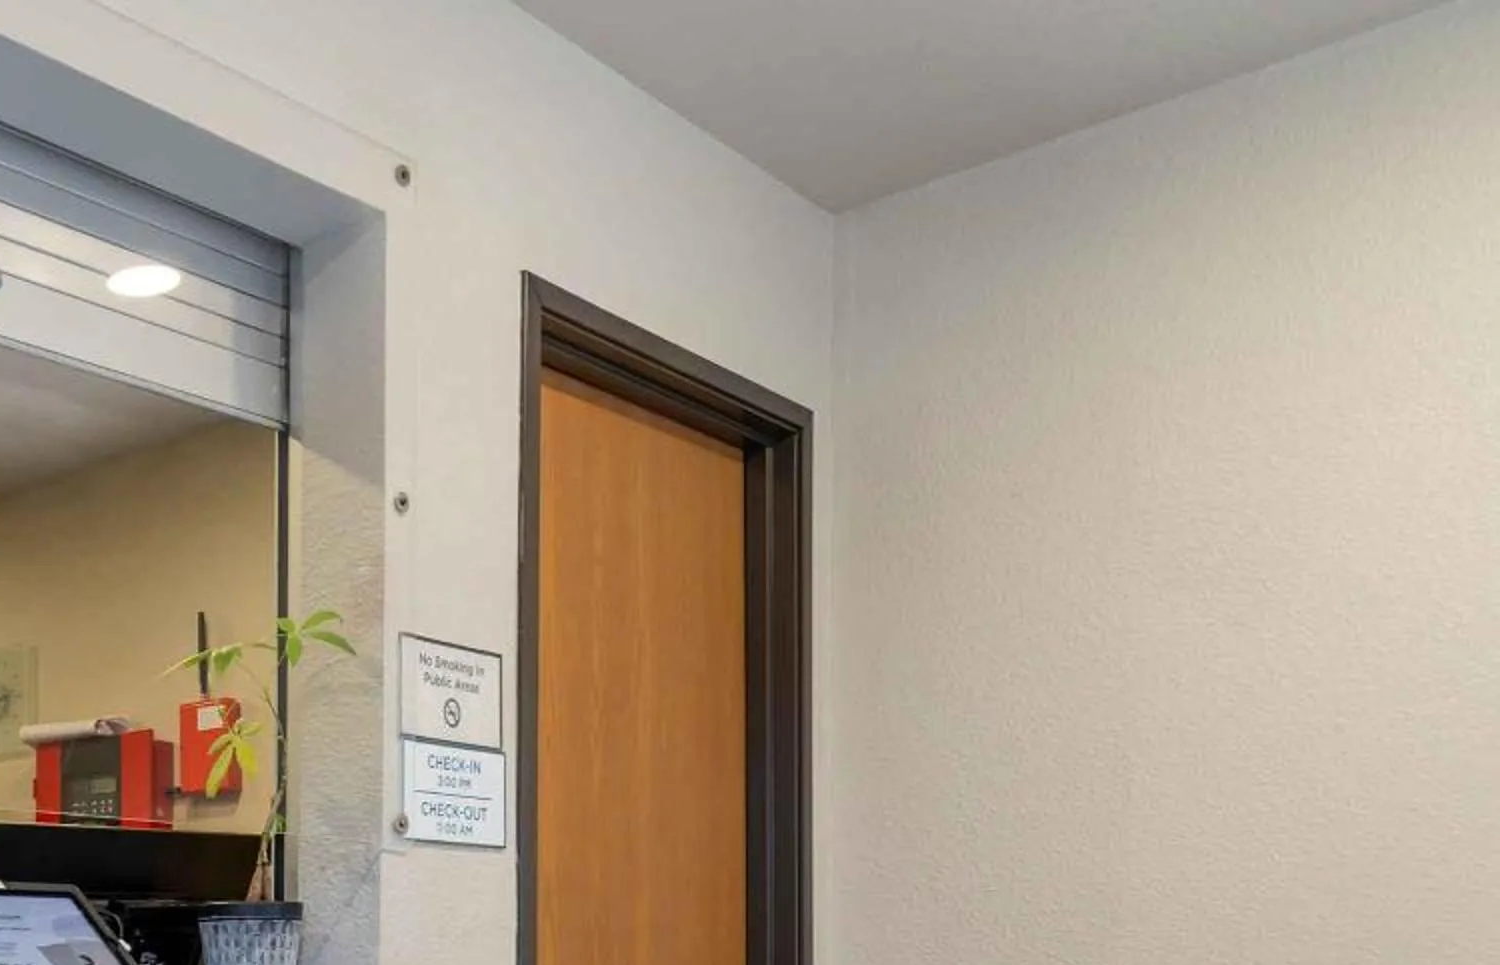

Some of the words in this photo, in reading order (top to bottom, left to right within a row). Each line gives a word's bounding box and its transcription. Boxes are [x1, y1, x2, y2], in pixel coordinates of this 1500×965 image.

[419, 651, 433, 667] No
[434, 655, 474, 677] Smoking
[423, 671, 453, 688] Public
[427, 753, 482, 775] CHECK-IN
[420, 801, 488, 821] CHECK-OUT
[459, 823, 474, 837] AM
